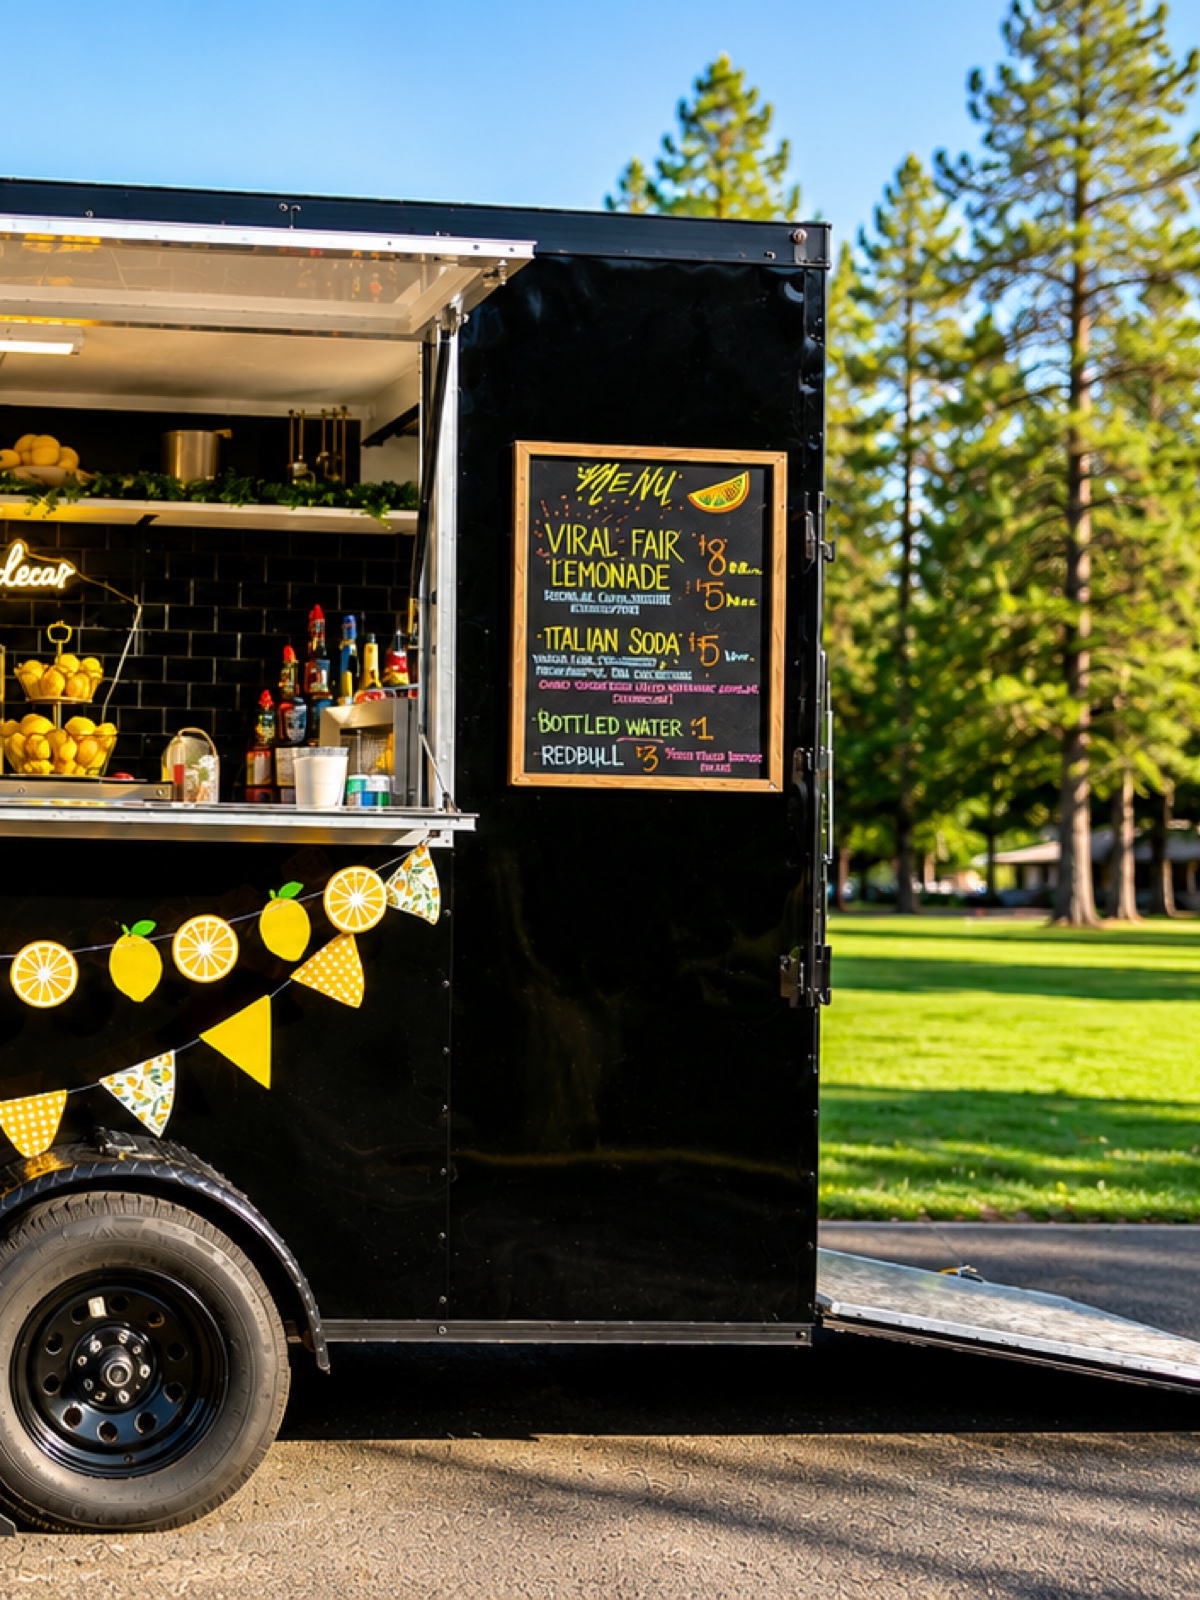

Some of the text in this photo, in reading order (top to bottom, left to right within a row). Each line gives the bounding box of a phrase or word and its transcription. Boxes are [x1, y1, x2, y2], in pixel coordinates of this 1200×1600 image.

[576, 464, 677, 506] MENU
[545, 523, 684, 563] VIRAL FAIR
[551, 561, 670, 591] LEMONADE
[544, 626, 618, 653] ITALIAN
[629, 628, 680, 655] SODA
[538, 709, 620, 735] BOTTLED
[625, 718, 683, 737] WATER
[542, 745, 624, 767] REDBULL
